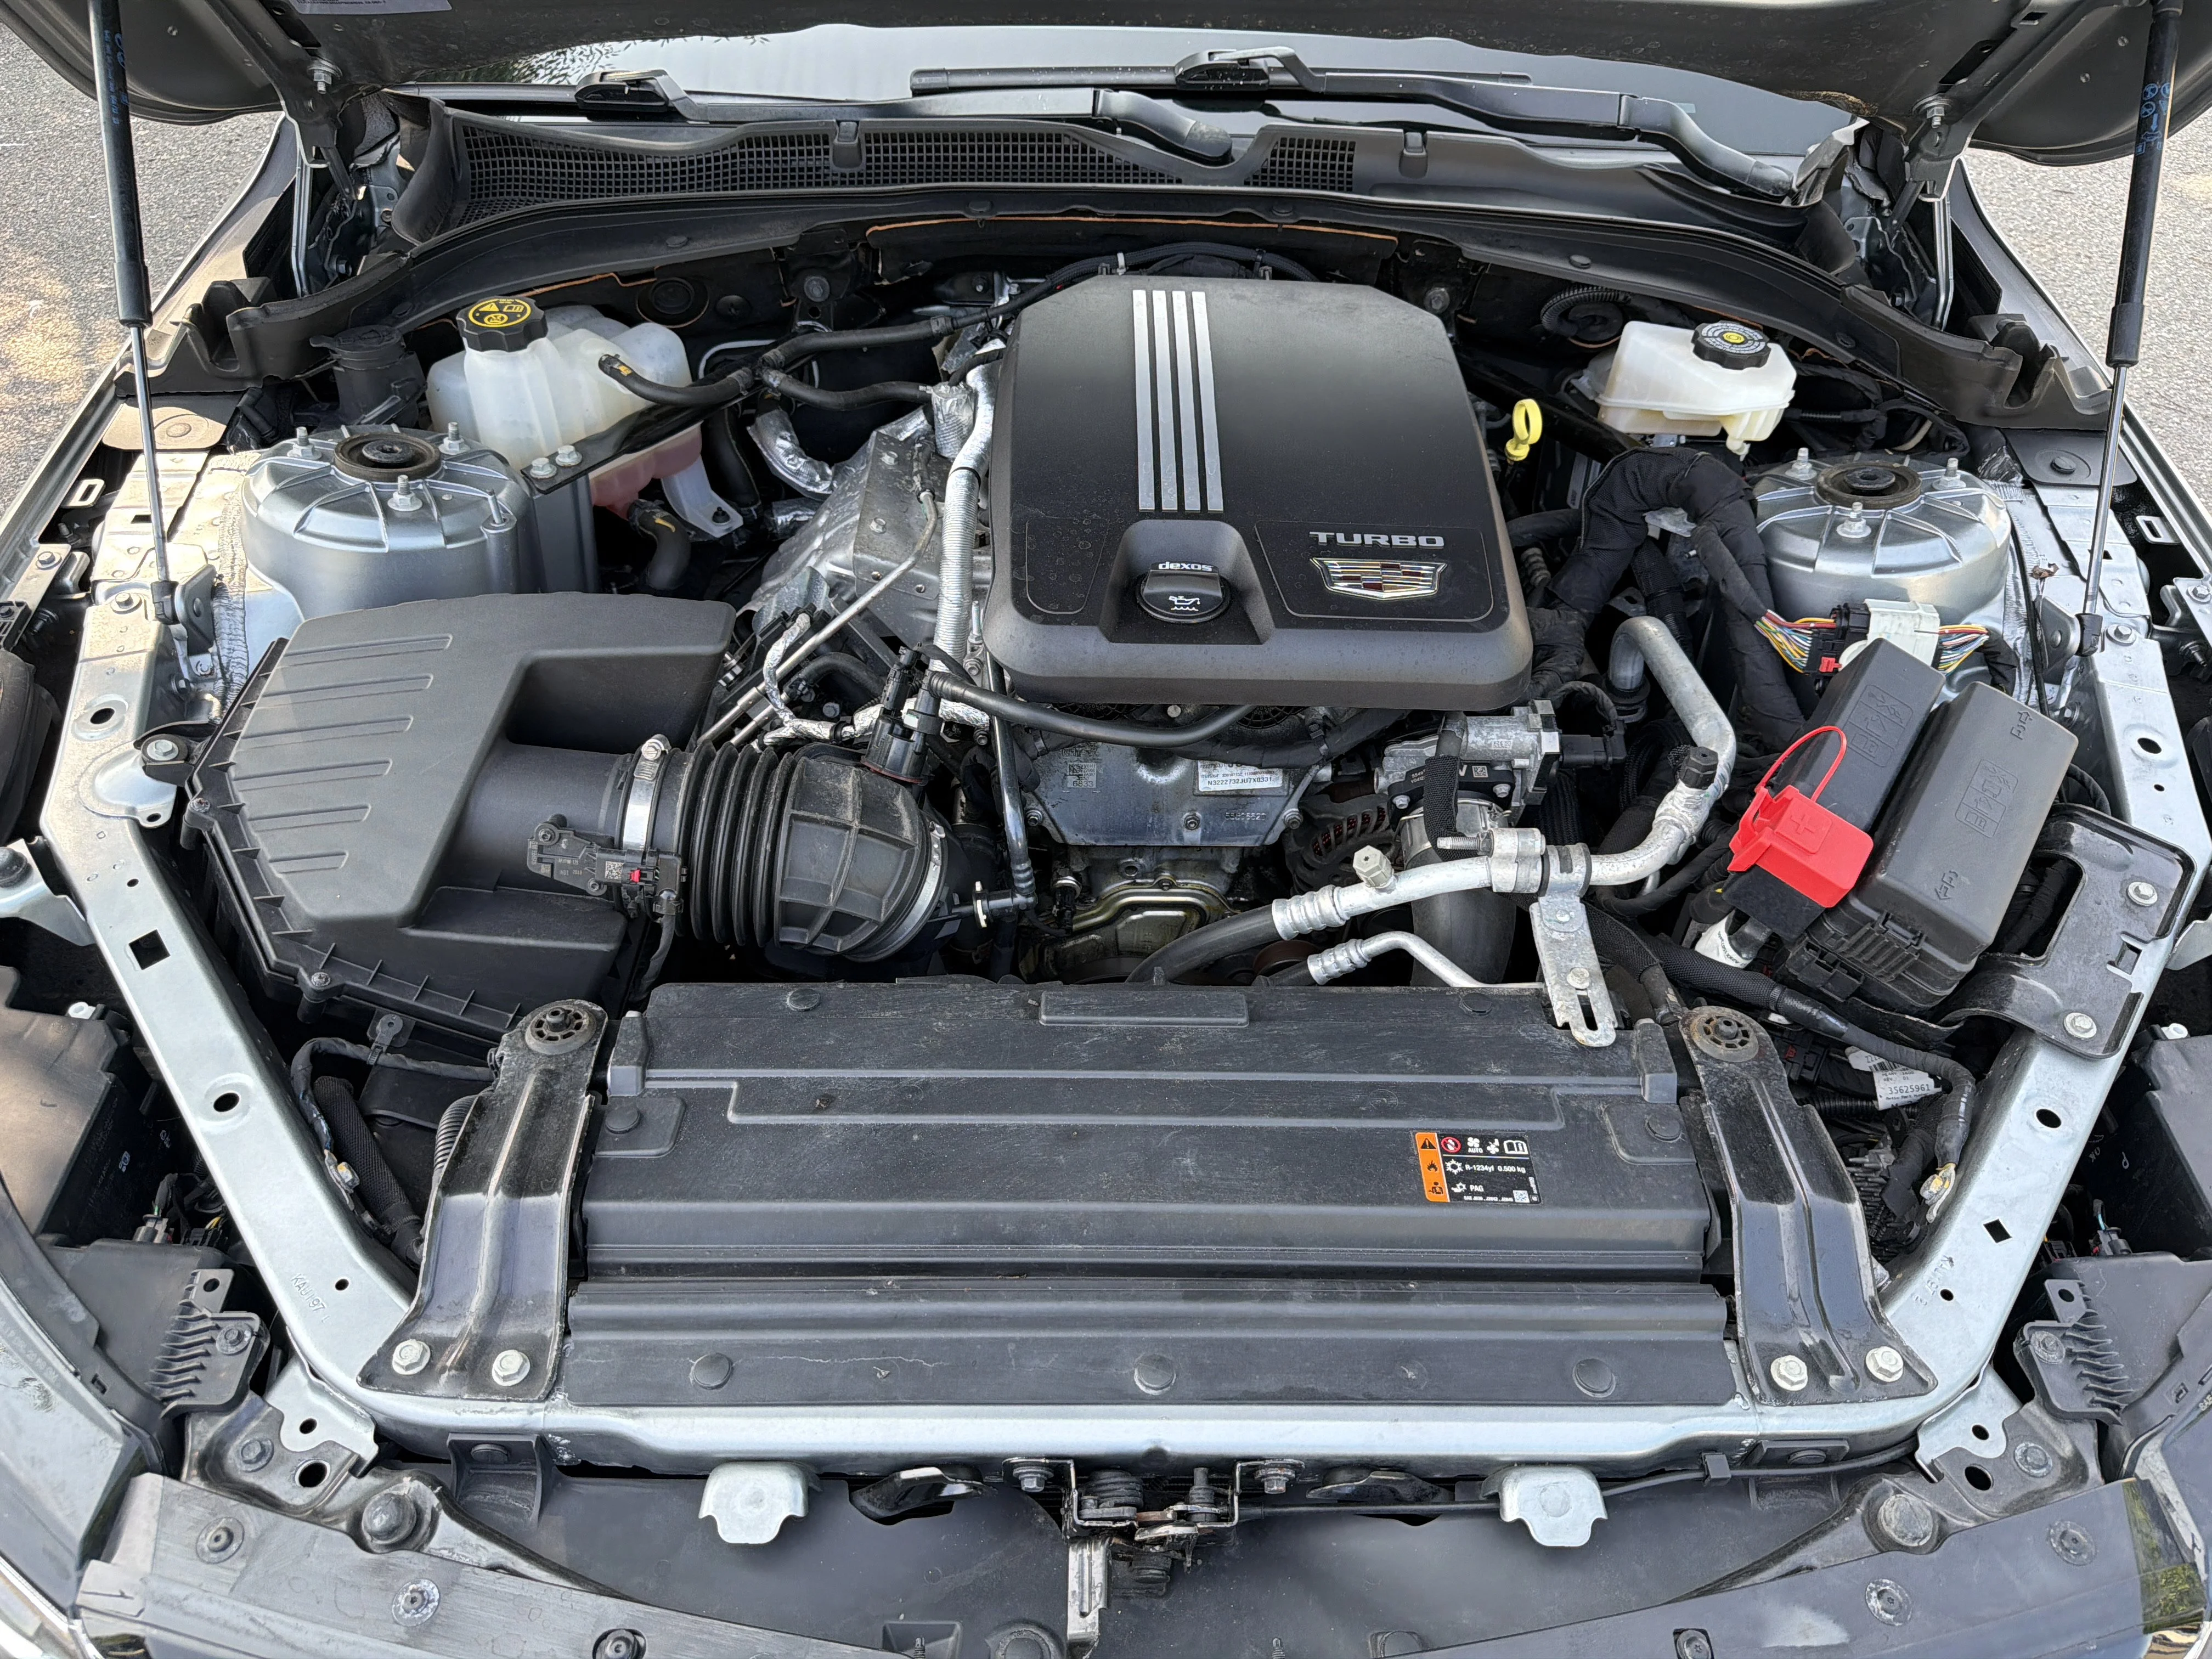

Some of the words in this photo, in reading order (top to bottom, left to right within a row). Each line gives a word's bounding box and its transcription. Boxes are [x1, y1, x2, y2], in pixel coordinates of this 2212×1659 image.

[1310, 532, 1444, 549] TURBO
[1158, 561, 1214, 572] dexos
[1888, 1084, 1931, 1095] 35625961
[1465, 1164, 1494, 1172] R-1234yf
